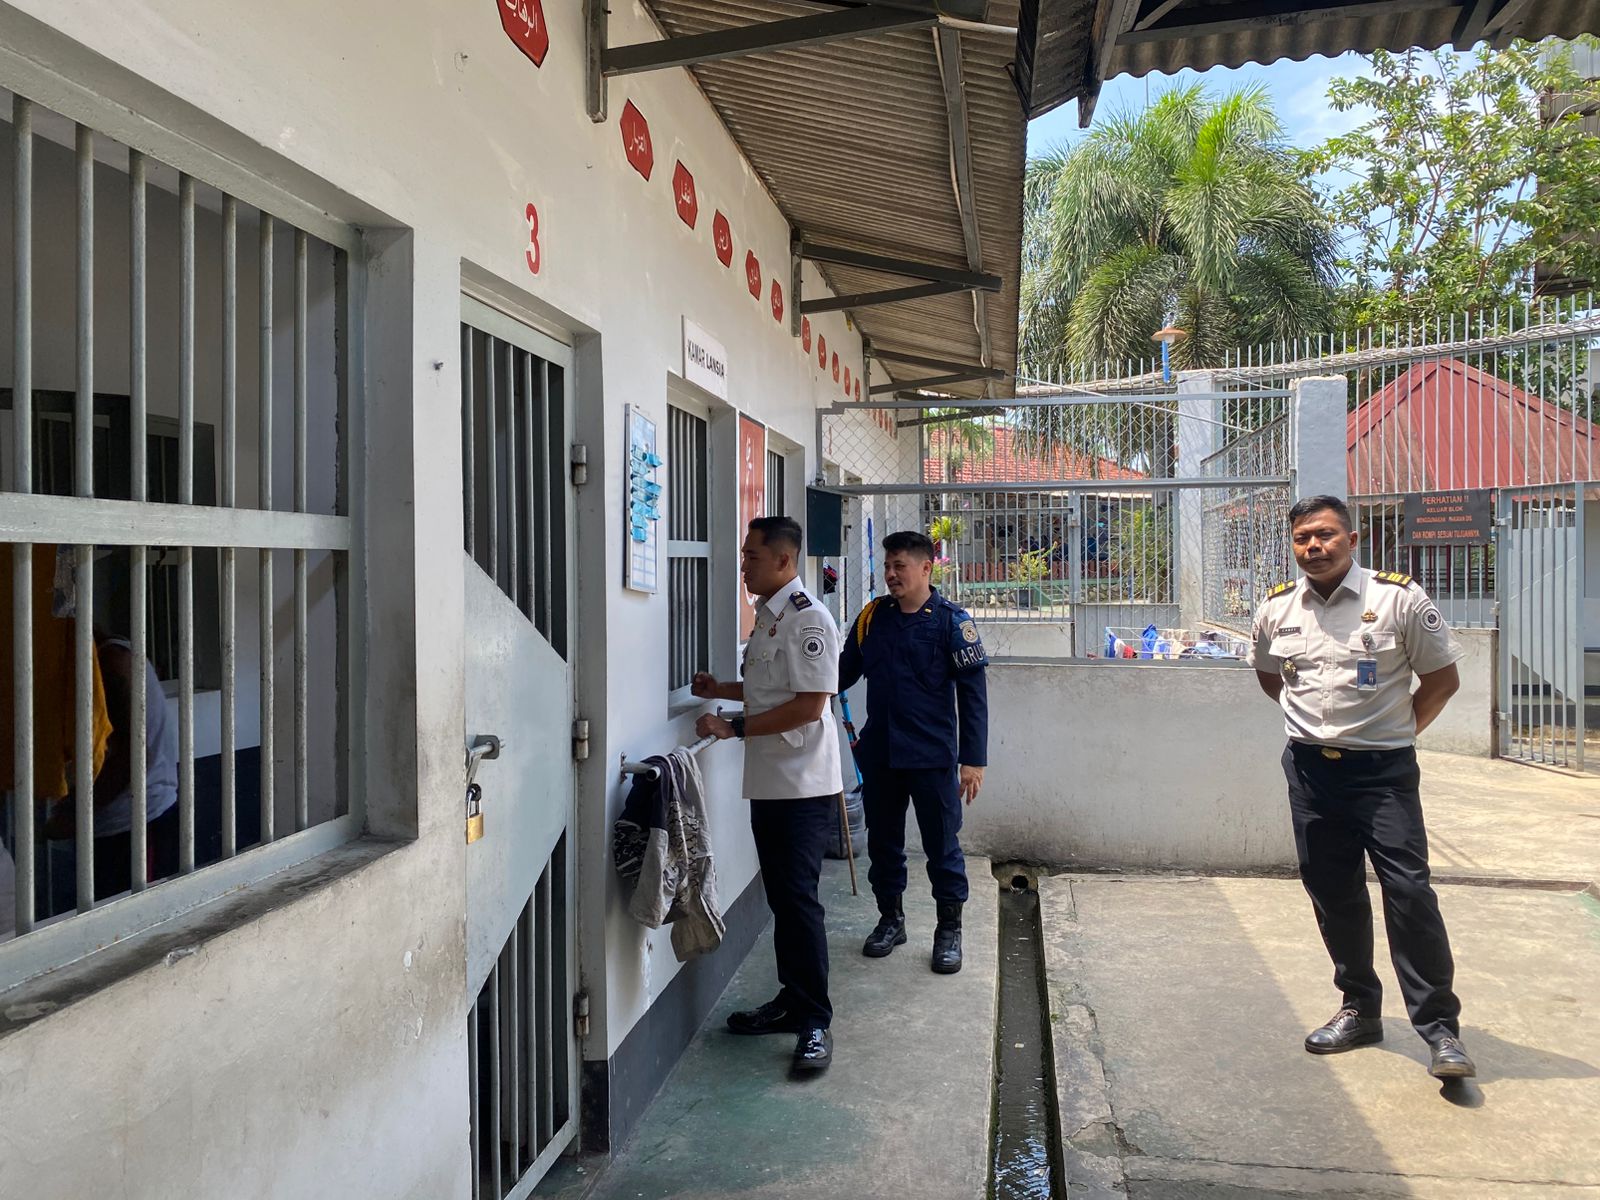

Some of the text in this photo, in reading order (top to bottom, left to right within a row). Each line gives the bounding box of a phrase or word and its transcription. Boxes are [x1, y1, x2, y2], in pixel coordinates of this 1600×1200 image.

[525, 202, 541, 275] 3
[687, 338, 726, 380] KAMAR LANSIA
[1421, 495, 1463, 504] PERHATIAN
